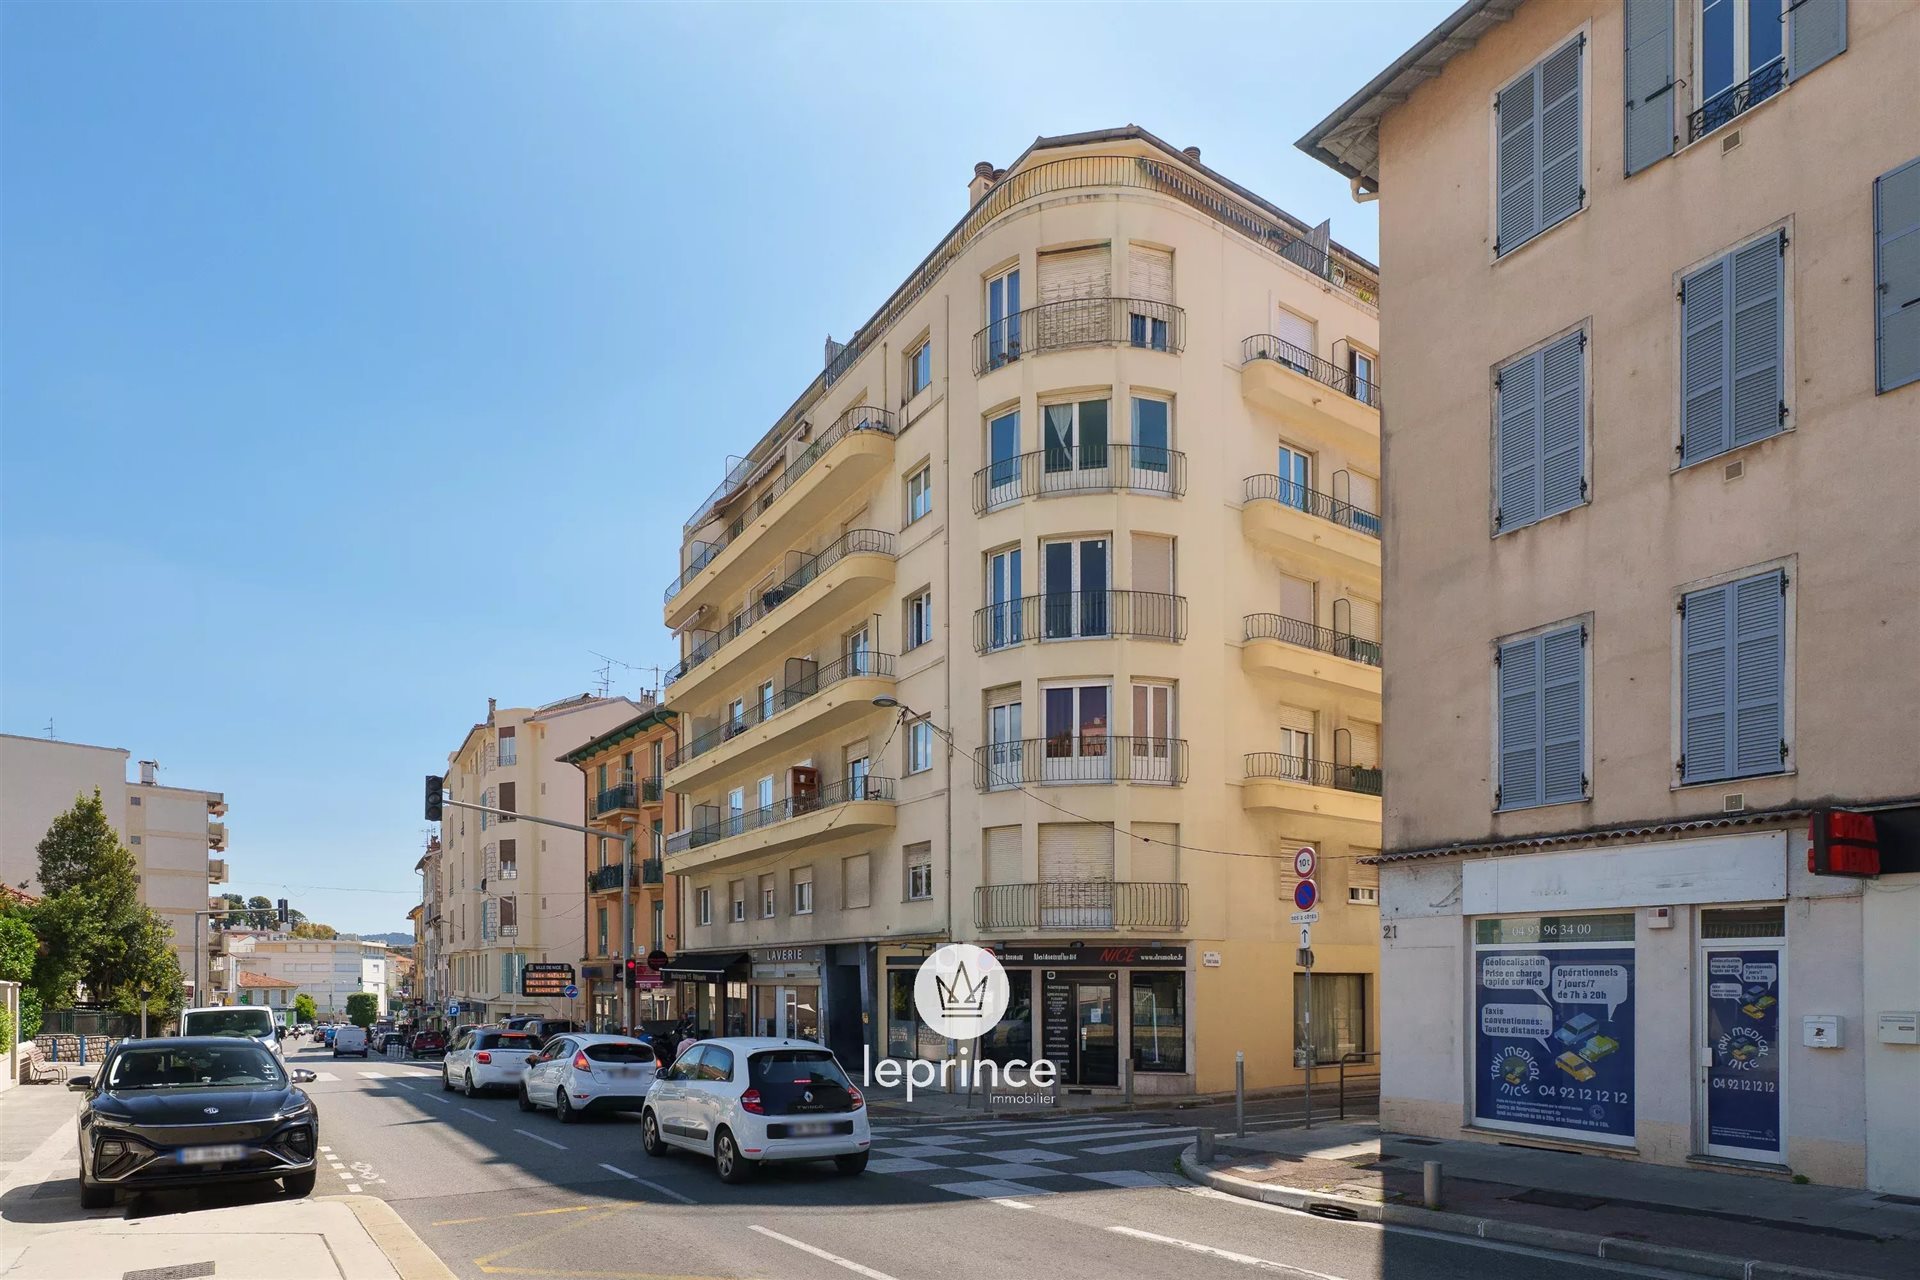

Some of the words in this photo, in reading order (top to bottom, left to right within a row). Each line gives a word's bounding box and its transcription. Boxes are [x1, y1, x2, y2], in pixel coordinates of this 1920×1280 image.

[1383, 925, 1397, 938] 21
[1512, 926, 1524, 936] 04
[1528, 925, 1540, 936] 93
[1544, 924, 1558, 935] 96
[1560, 924, 1574, 934] 34
[1577, 924, 1592, 934] 00
[766, 949, 802, 961] LAVERIE
[1100, 948, 1139, 962] NICE
[1485, 958, 1545, 966] Géolocalisation
[1485, 970, 1504, 978] Prise
[1516, 970, 1542, 980] charge
[1557, 968, 1618, 978] Opérationnels
[1485, 978, 1510, 987] rapide
[1526, 978, 1544, 986] Nice
[1564, 979, 1595, 989] jours/7
[1557, 991, 1568, 999] de
[1570, 991, 1580, 1000] 7h
[1582, 990, 1588, 1000] à
[1590, 991, 1607, 1000] 20h
[1484, 1016, 1543, 1026] conventionnés:
[1484, 1026, 1509, 1034] Toutes
[1511, 1026, 1550, 1036] distances
[1718, 1033, 1732, 1056] TAXI
[1732, 1026, 1769, 1057] MEDICAL
[1490, 1052, 1504, 1080] TAXI
[1504, 1046, 1540, 1081] MEDICAL
[1728, 1058, 1759, 1071] NICE
[1500, 1082, 1531, 1097] NICE
[1713, 1078, 1726, 1088] 04
[1728, 1079, 1739, 1090] 92
[1741, 1080, 1751, 1091] 12
[1753, 1081, 1762, 1092] 12
[1765, 1082, 1775, 1093] 12
[1538, 1085, 1556, 1097] 04
[1559, 1087, 1575, 1099] 92
[1578, 1089, 1592, 1100] 12
[1596, 1090, 1610, 1102] 12
[1614, 1092, 1628, 1104] 12
